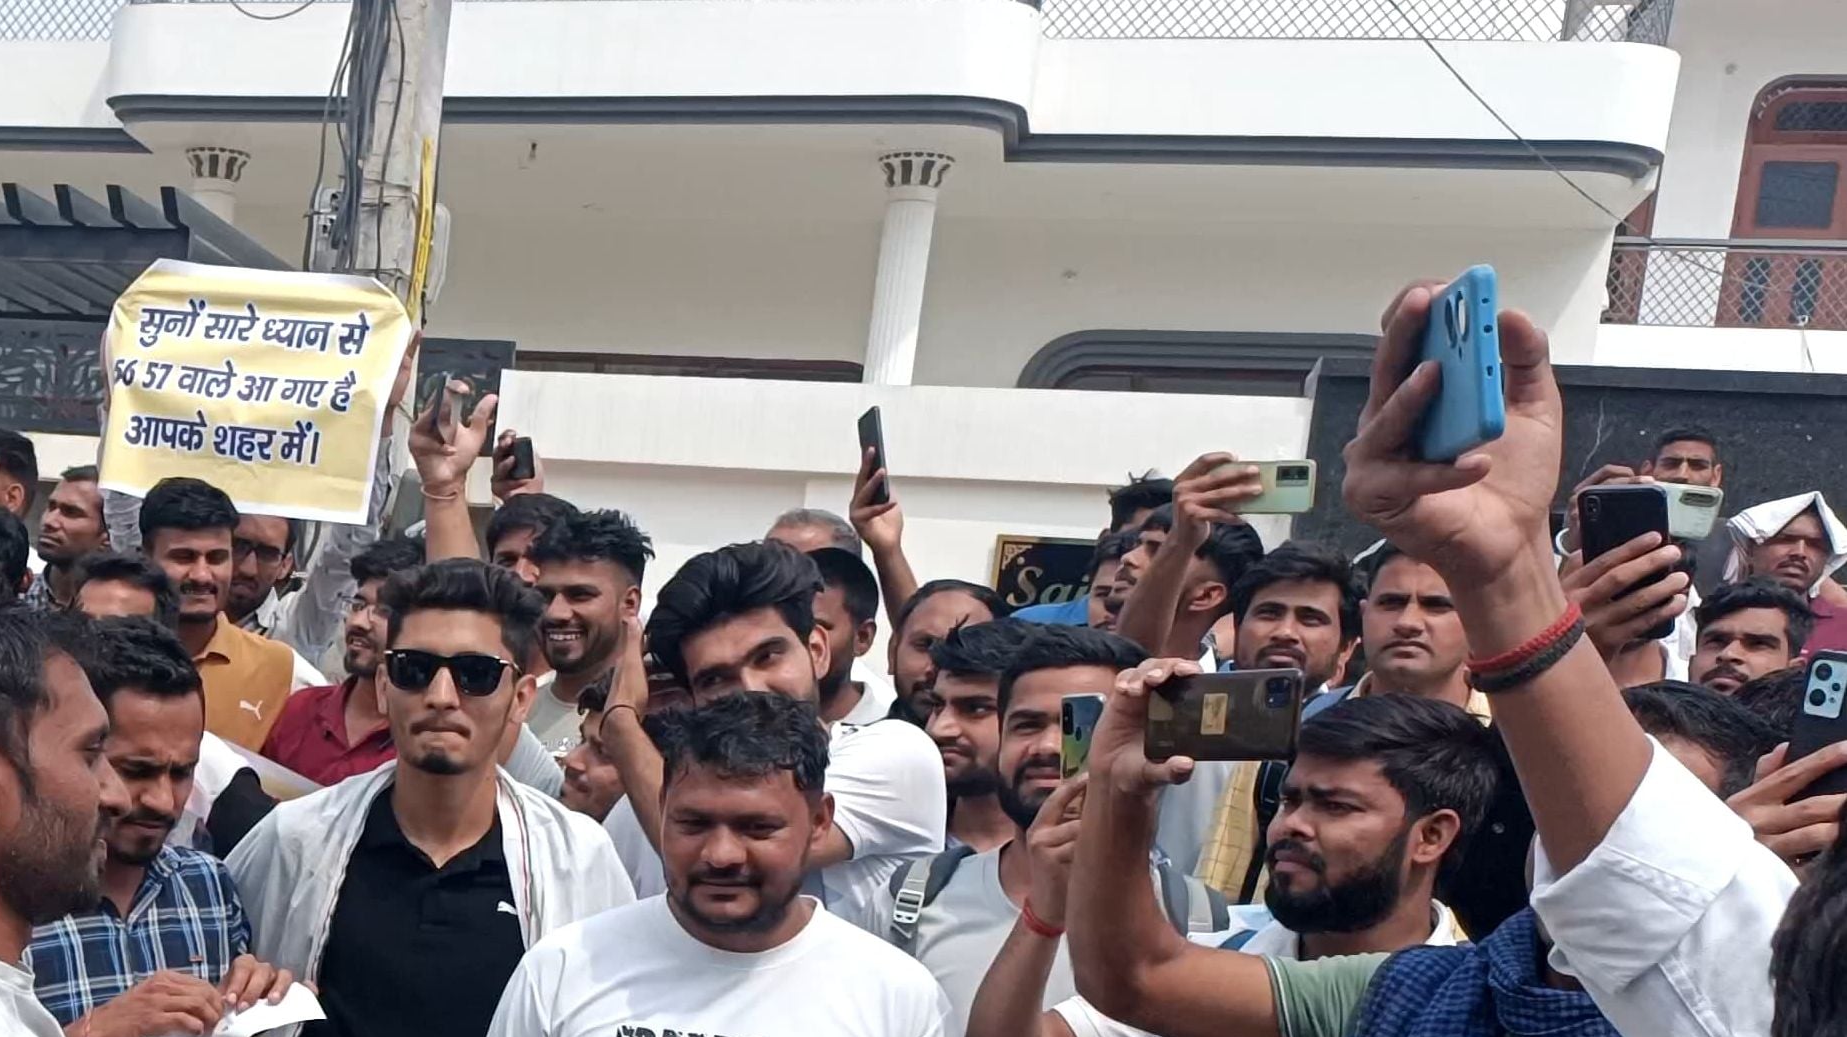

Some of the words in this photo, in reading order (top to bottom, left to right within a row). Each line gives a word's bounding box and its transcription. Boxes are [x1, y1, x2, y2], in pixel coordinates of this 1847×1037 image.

[204, 304, 260, 342] सारे
[262, 318, 334, 352] ध्यान
[338, 312, 371, 355] से
[142, 361, 174, 390] 57
[177, 360, 238, 399] वाले
[237, 375, 278, 402] आ
[280, 379, 328, 408] गए
[124, 411, 208, 451] आपके
[213, 425, 276, 461] शहर
